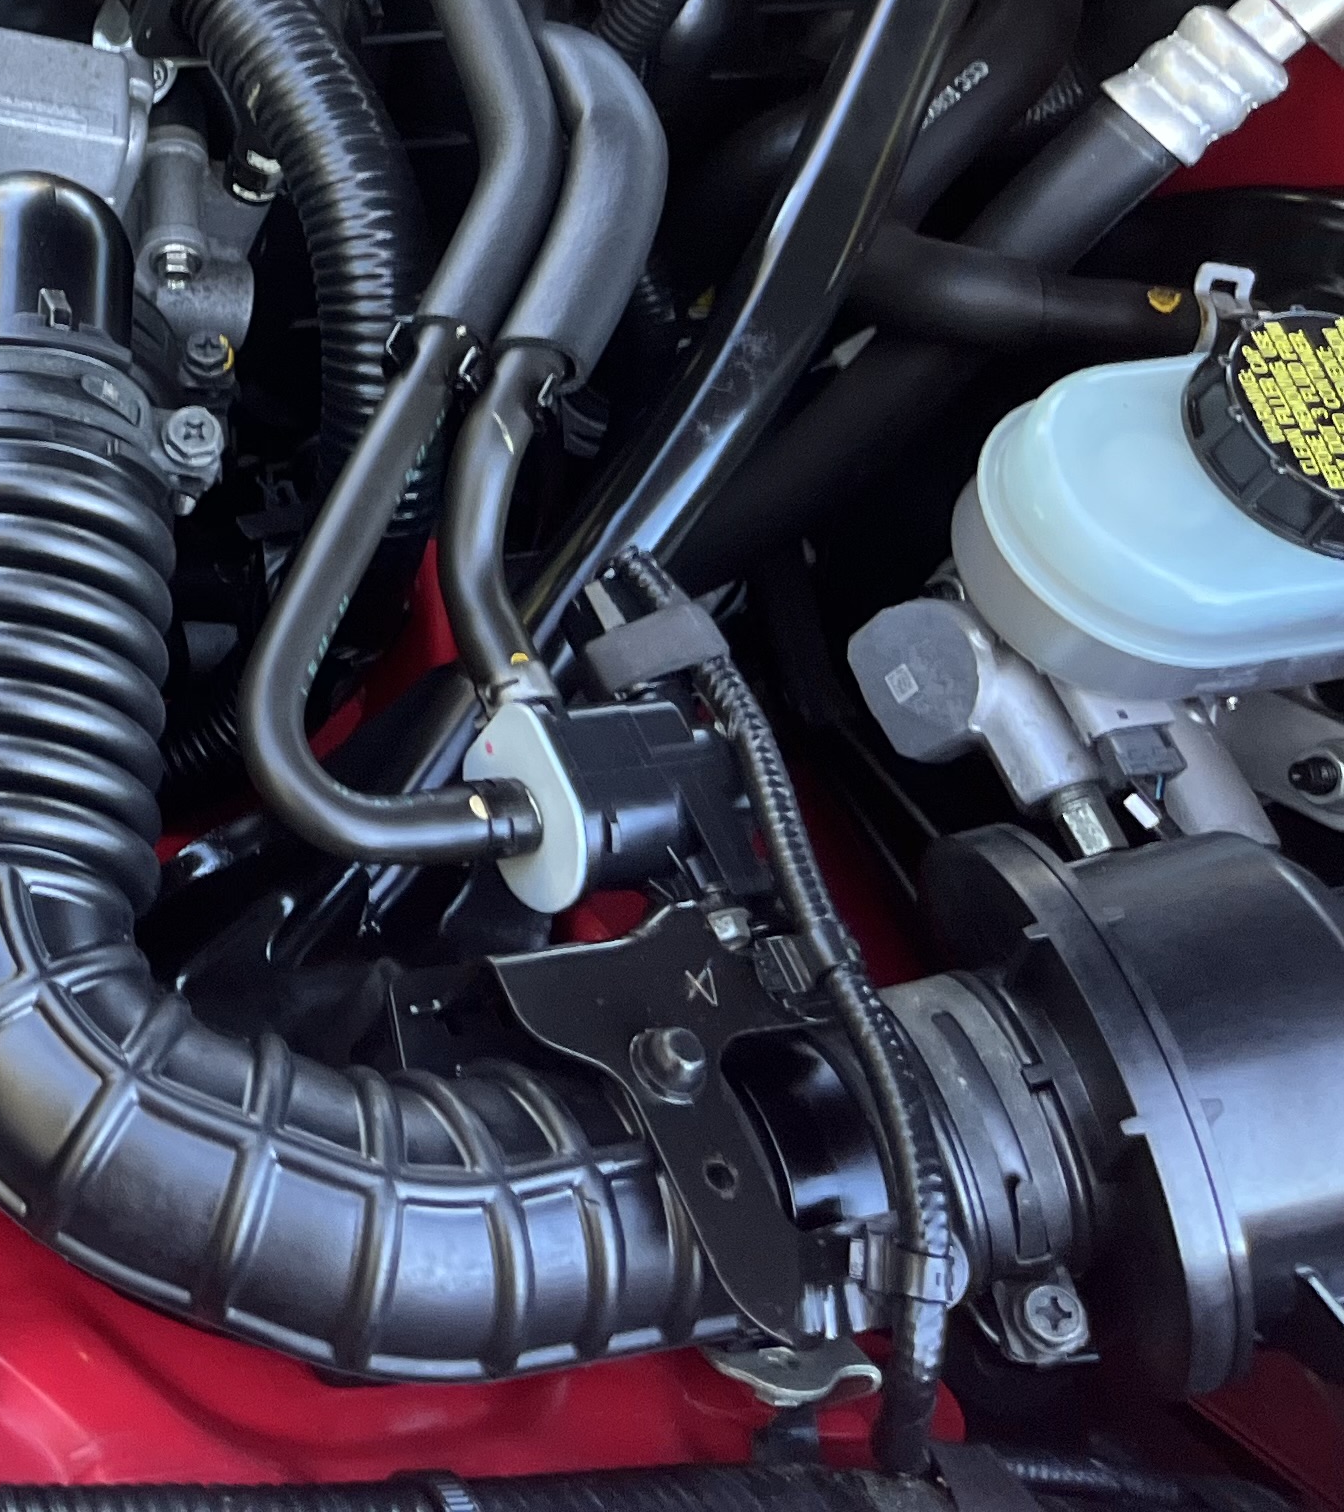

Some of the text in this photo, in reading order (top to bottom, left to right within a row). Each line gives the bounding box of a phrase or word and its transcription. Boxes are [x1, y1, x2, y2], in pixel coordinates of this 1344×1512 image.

[1251, 330, 1278, 357] USE
[1285, 362, 1322, 402] FLUID
[1241, 346, 1321, 475] CLEAN FILLER CAP
[1310, 407, 1329, 420] 3
[1303, 433, 1344, 489] BEFORE
